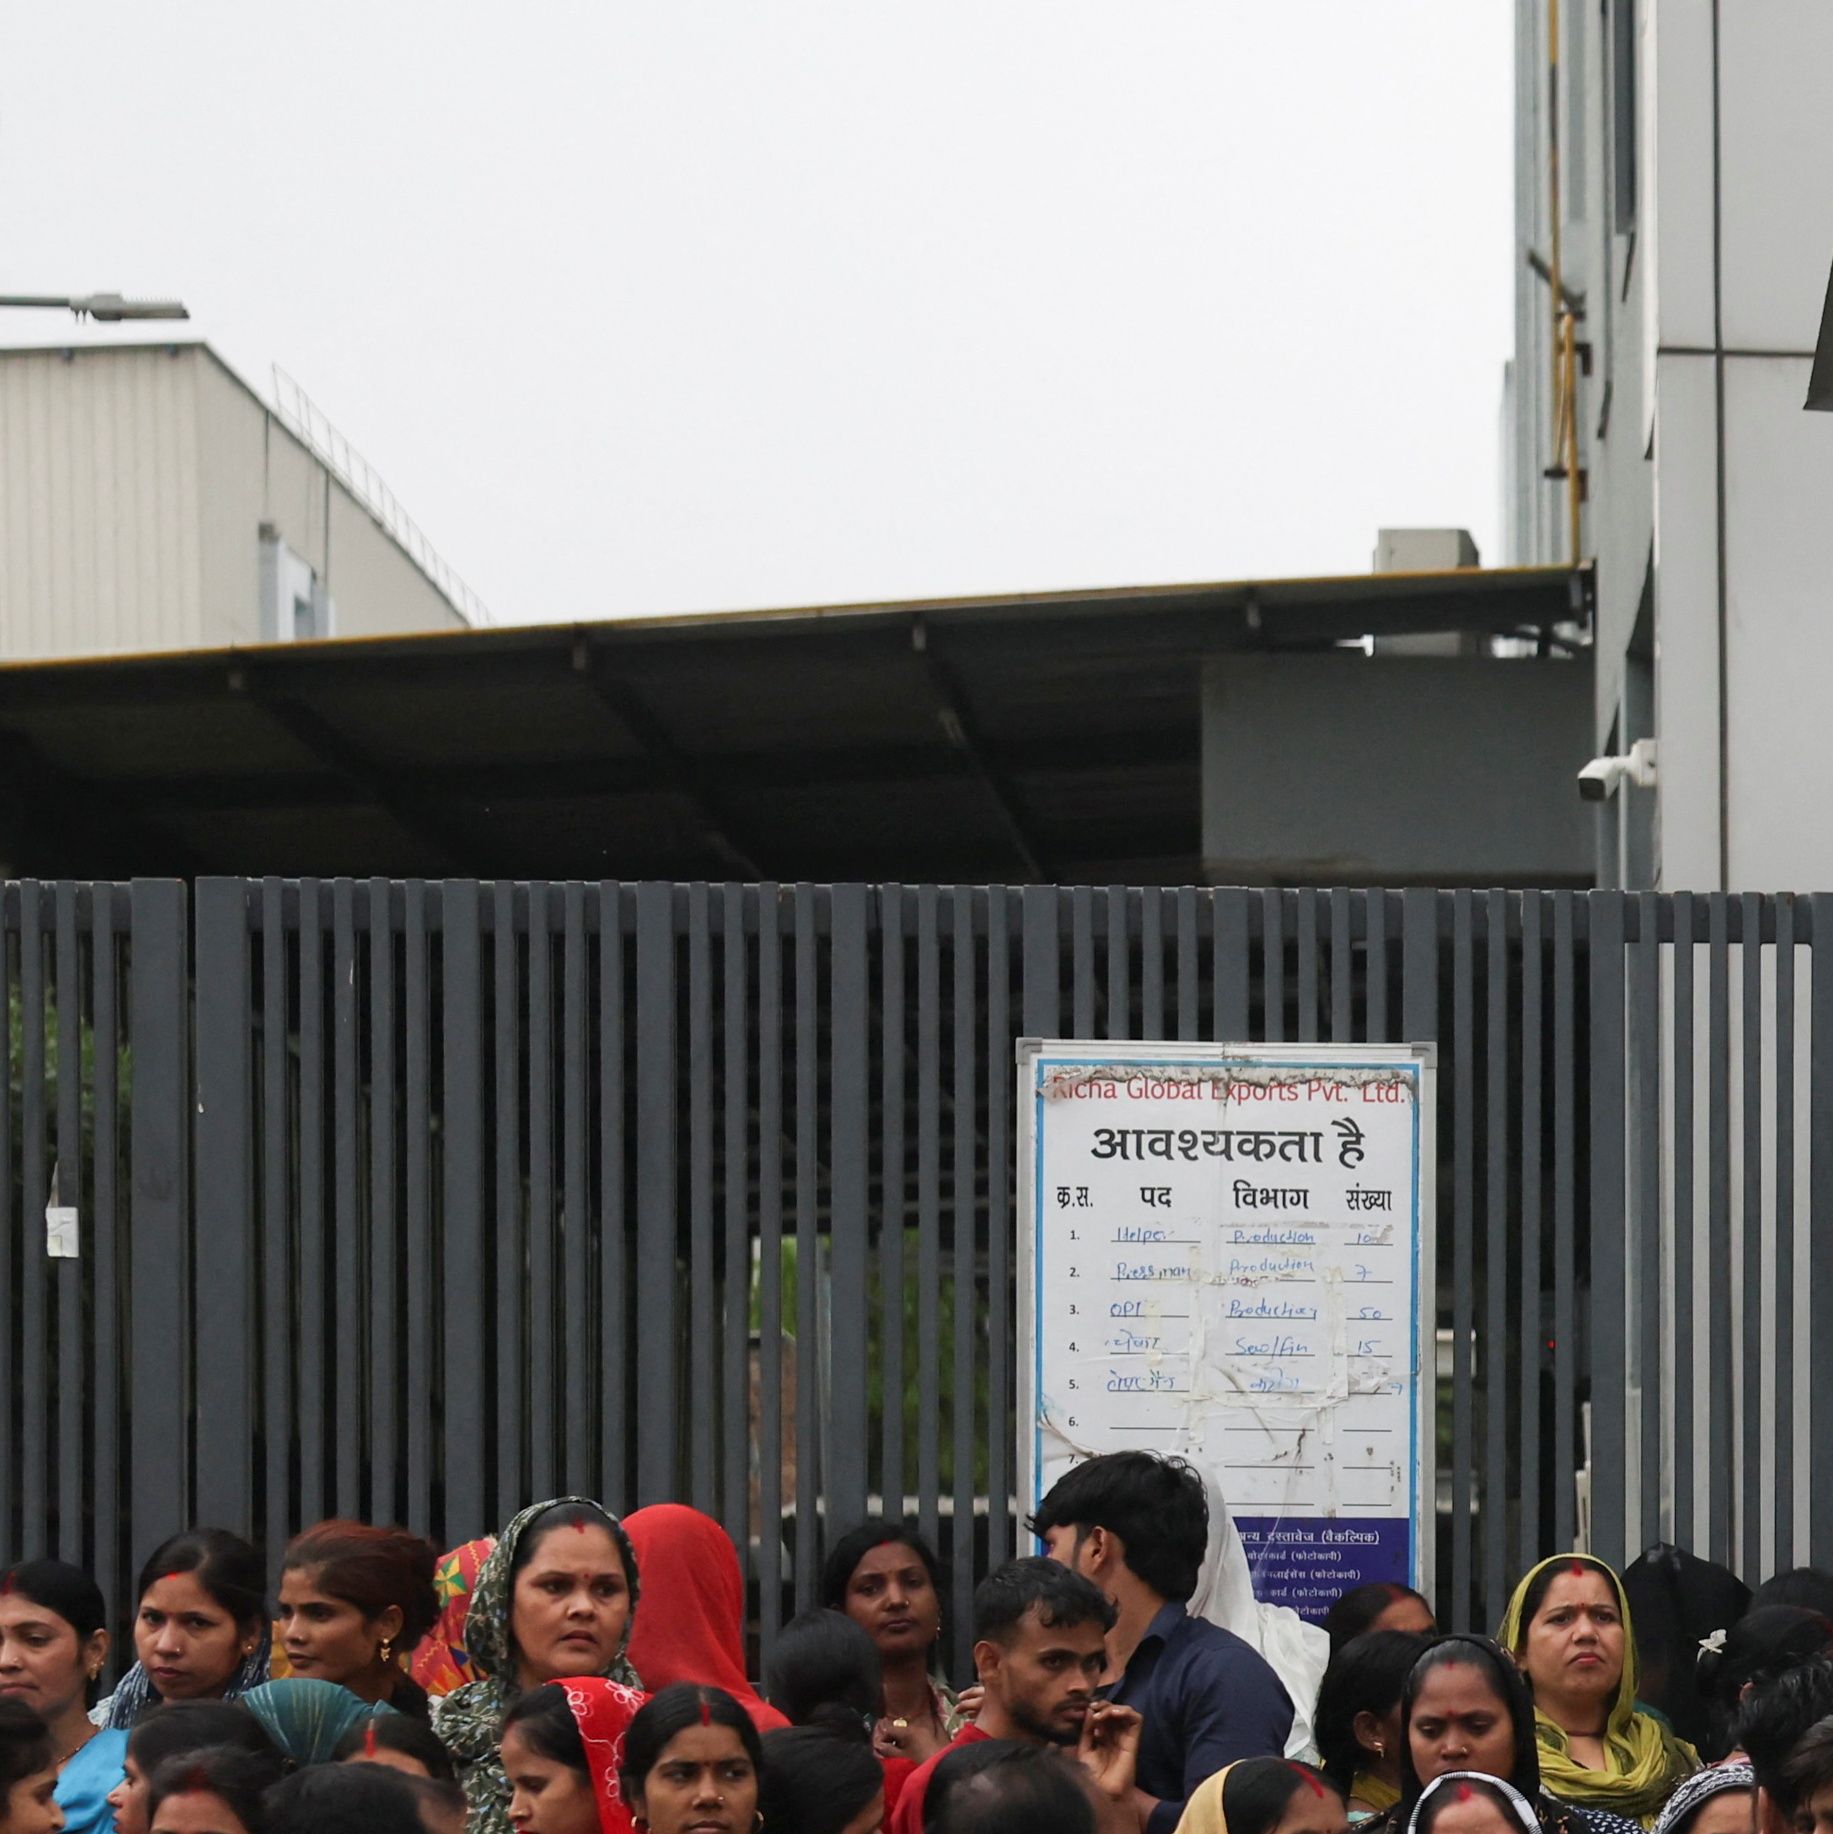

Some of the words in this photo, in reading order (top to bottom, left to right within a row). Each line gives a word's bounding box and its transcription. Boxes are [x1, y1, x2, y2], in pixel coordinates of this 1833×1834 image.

[1126, 1077, 1202, 1101] Global
[1211, 1078, 1299, 1107] Exports
[1308, 1079, 1348, 1104] Pvt.
[1361, 1081, 1406, 1105] Ltd.
[1091, 1129, 1323, 1162] आवश्यकता
[1331, 1117, 1365, 1169] है
[1140, 1187, 1172, 1207] पद
[1233, 1180, 1309, 1209] विभाग
[1346, 1183, 1391, 1210] संख्या
[1071, 1230, 1080, 1240] 1.
[1117, 1227, 1167, 1245] Helpe
[1070, 1267, 1079, 1277] 2.
[1070, 1305, 1079, 1314] 3.
[1069, 1342, 1079, 1352] 4.
[1069, 1379, 1079, 1389] 5.
[1069, 1417, 1078, 1426] 6.
